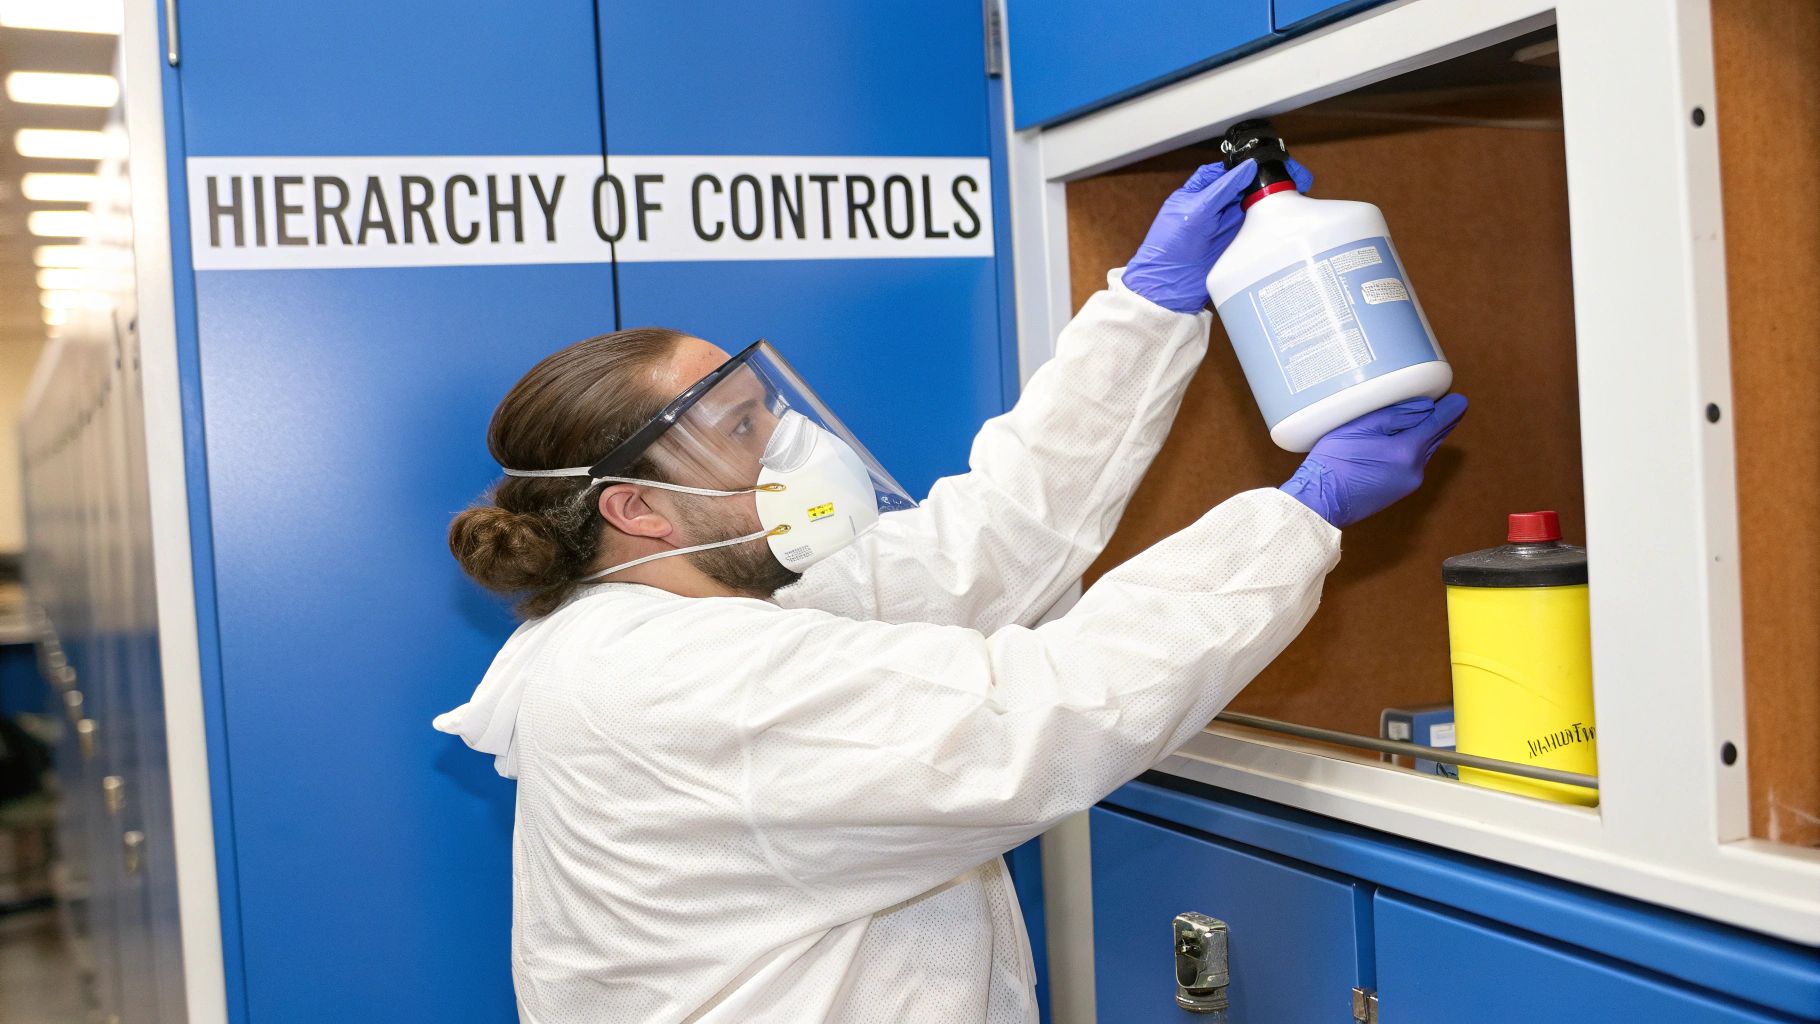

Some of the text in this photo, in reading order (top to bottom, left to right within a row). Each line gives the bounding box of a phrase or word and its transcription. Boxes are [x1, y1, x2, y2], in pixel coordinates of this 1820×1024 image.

[206, 173, 981, 246] HIERARCHY OF CONTROLS
